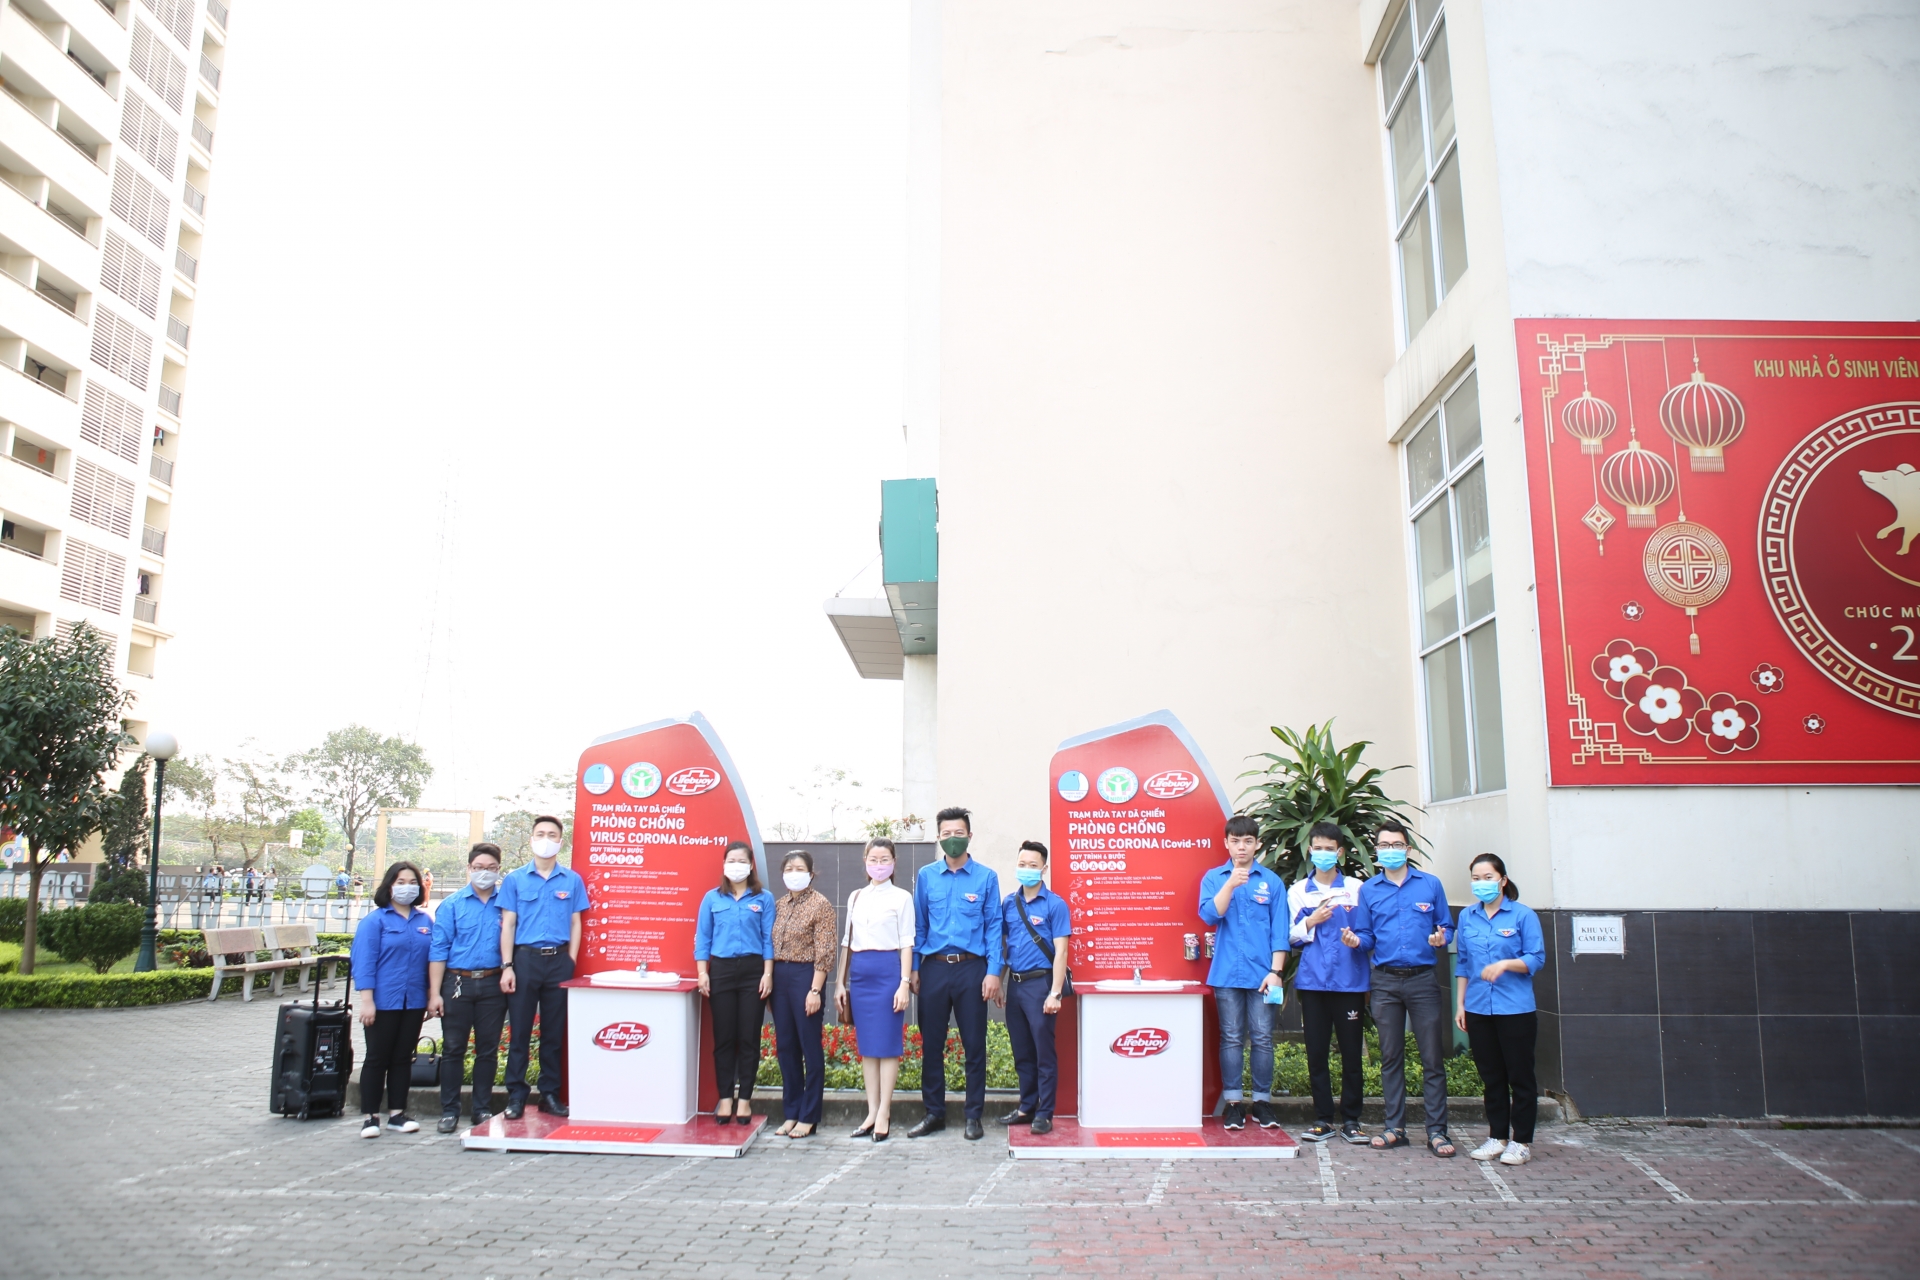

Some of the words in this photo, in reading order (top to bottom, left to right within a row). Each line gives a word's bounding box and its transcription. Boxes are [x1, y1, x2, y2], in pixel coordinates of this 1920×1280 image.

[1754, 360, 1785, 378] KHU
[1788, 354, 1824, 378] NHÀ
[1826, 354, 1840, 378] Ở
[1844, 360, 1880, 378] SINH
[1882, 356, 1920, 378] VIÊN
[1844, 604, 1893, 618] CHÚC
[672, 776, 714, 786] Lifebuoy
[1150, 777, 1192, 788] Lifebuoy
[592, 804, 613, 813] TRẠM
[615, 802, 632, 812] RỬA
[650, 804, 660, 813] DÃ
[662, 803, 685, 814] CHIẾN
[1068, 811, 1090, 820] TRẠM
[1094, 809, 1110, 818] RỬA
[1128, 809, 1139, 818] DÃ
[1141, 807, 1165, 818] CHIẾN
[591, 813, 636, 828] PHÒNG
[639, 814, 685, 830] CHỐNG
[1069, 820, 1116, 834] PHÒNG
[1119, 818, 1166, 834] CHỐNG
[590, 832, 625, 843] VIRUS
[628, 833, 677, 845] CORONA
[679, 835, 728, 846] (Covid-19)
[1068, 838, 1105, 849] VIRUS
[1108, 838, 1159, 849] CORONA
[1161, 839, 1211, 849] (Covid-19)
[598, 1030, 648, 1042] Lifebuoy
[1116, 1038, 1167, 1048] Lifebuoy
